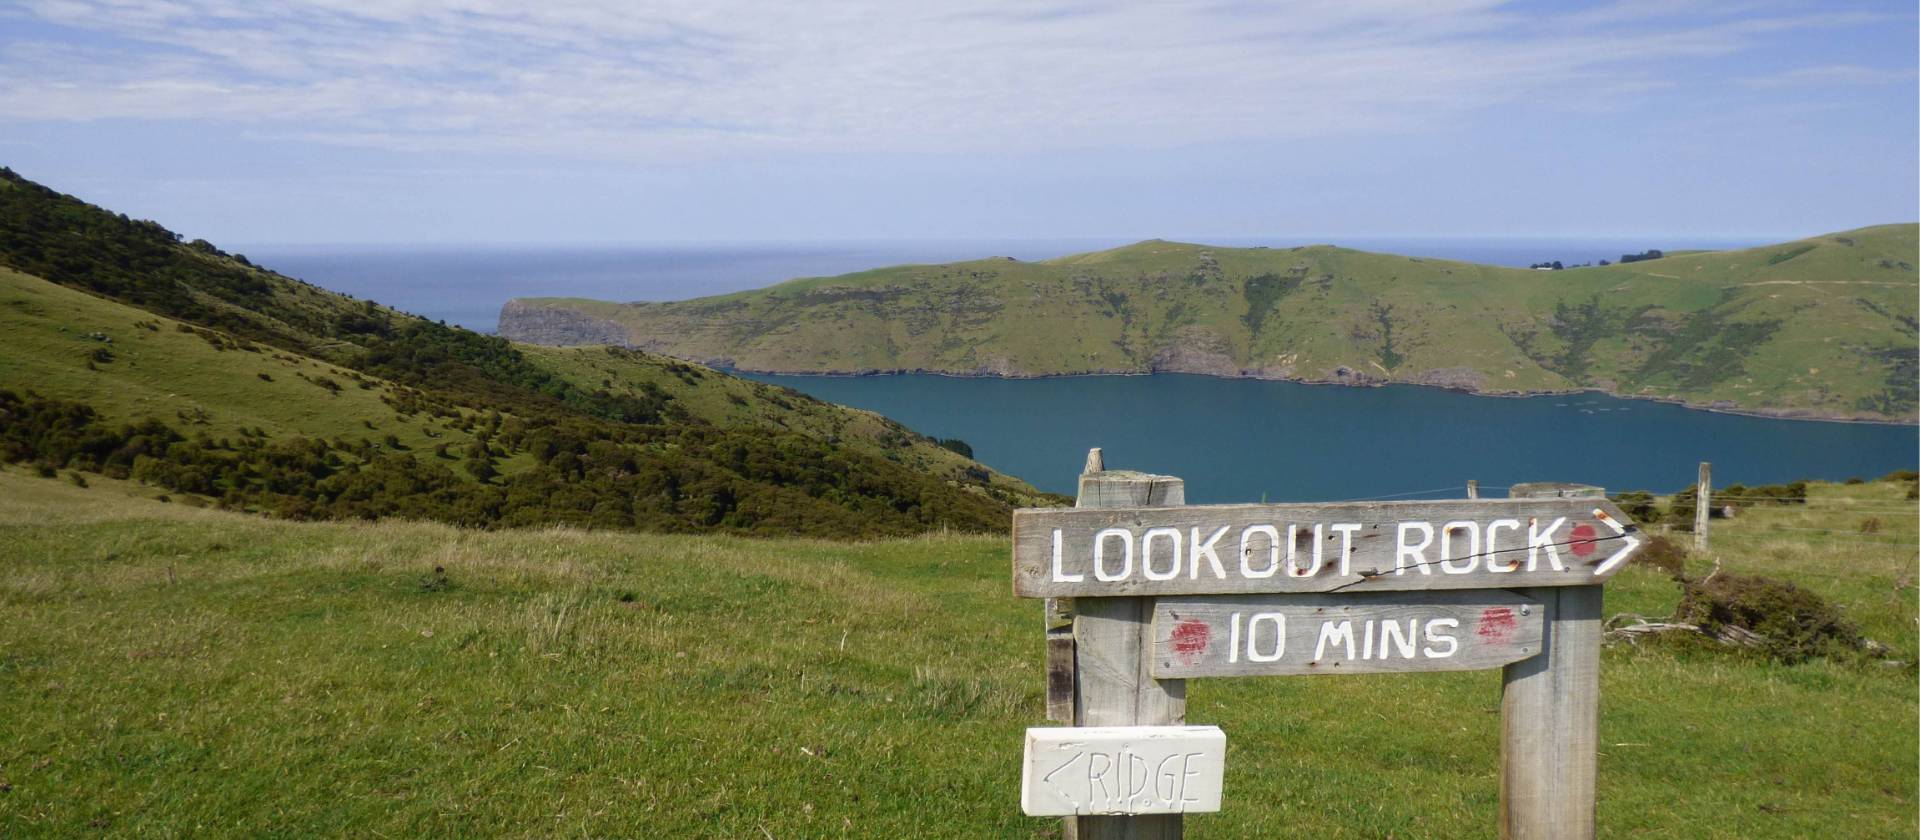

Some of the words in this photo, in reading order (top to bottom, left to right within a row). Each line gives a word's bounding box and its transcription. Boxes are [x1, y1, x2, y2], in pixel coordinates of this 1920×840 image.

[1052, 522, 1362, 584] LOOKOUT
[1395, 516, 1568, 577] ROCK
[1228, 612, 1286, 664] 10
[1314, 617, 1460, 661] MINS
[1088, 751, 1206, 813] RIDGE
